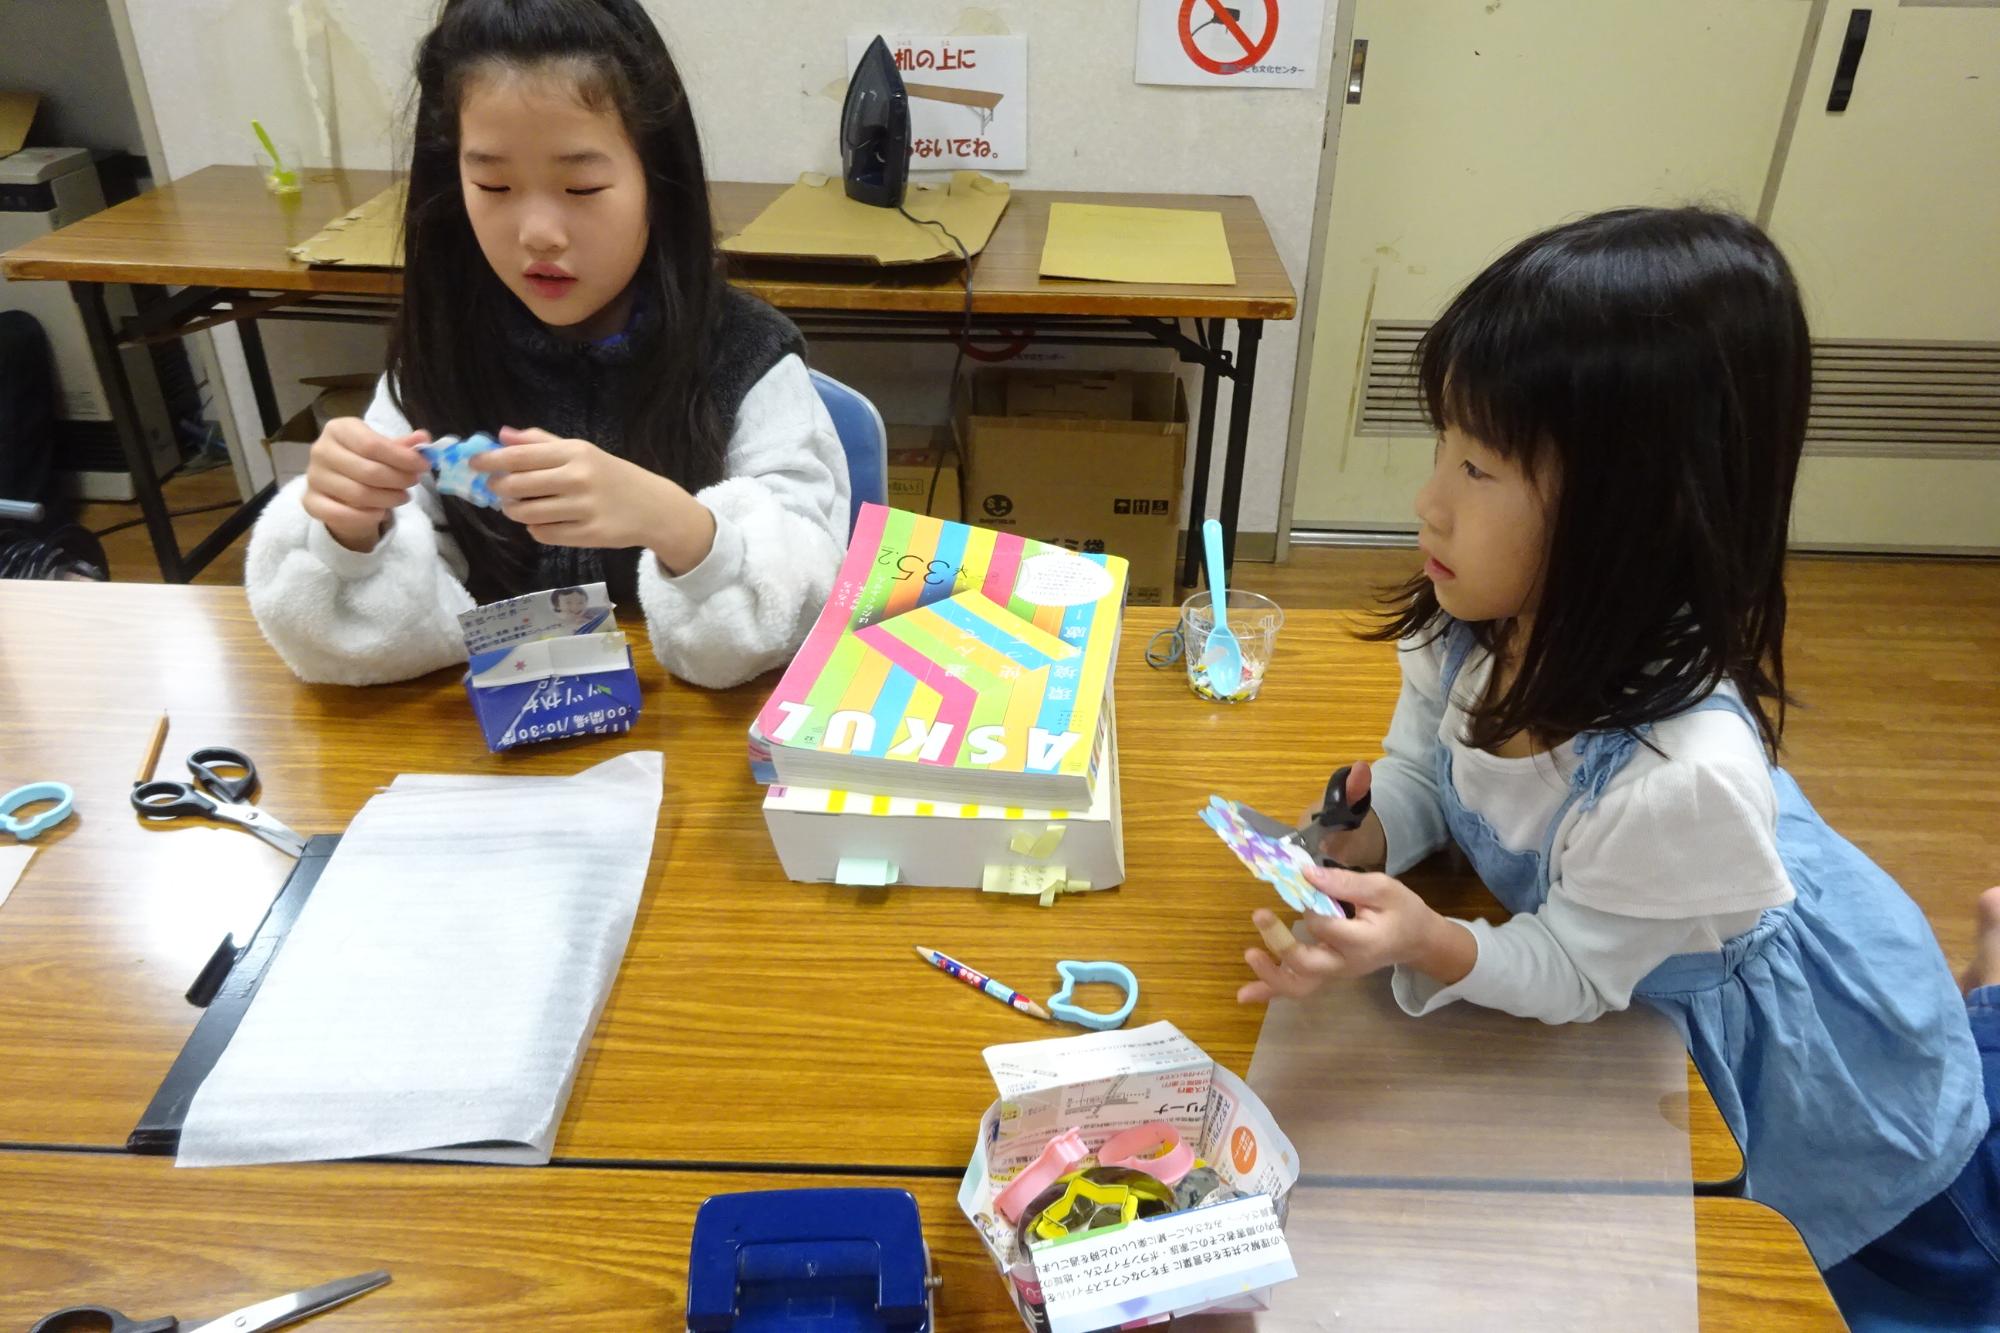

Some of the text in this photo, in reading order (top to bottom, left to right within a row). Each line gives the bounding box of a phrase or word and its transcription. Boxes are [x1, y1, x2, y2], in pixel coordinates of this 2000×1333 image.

[894, 48, 976, 71] 机の上に
[771, 701, 1081, 770] ASKUL
[1042, 1263, 1170, 1303] 手をつなぐフェスティバルを
